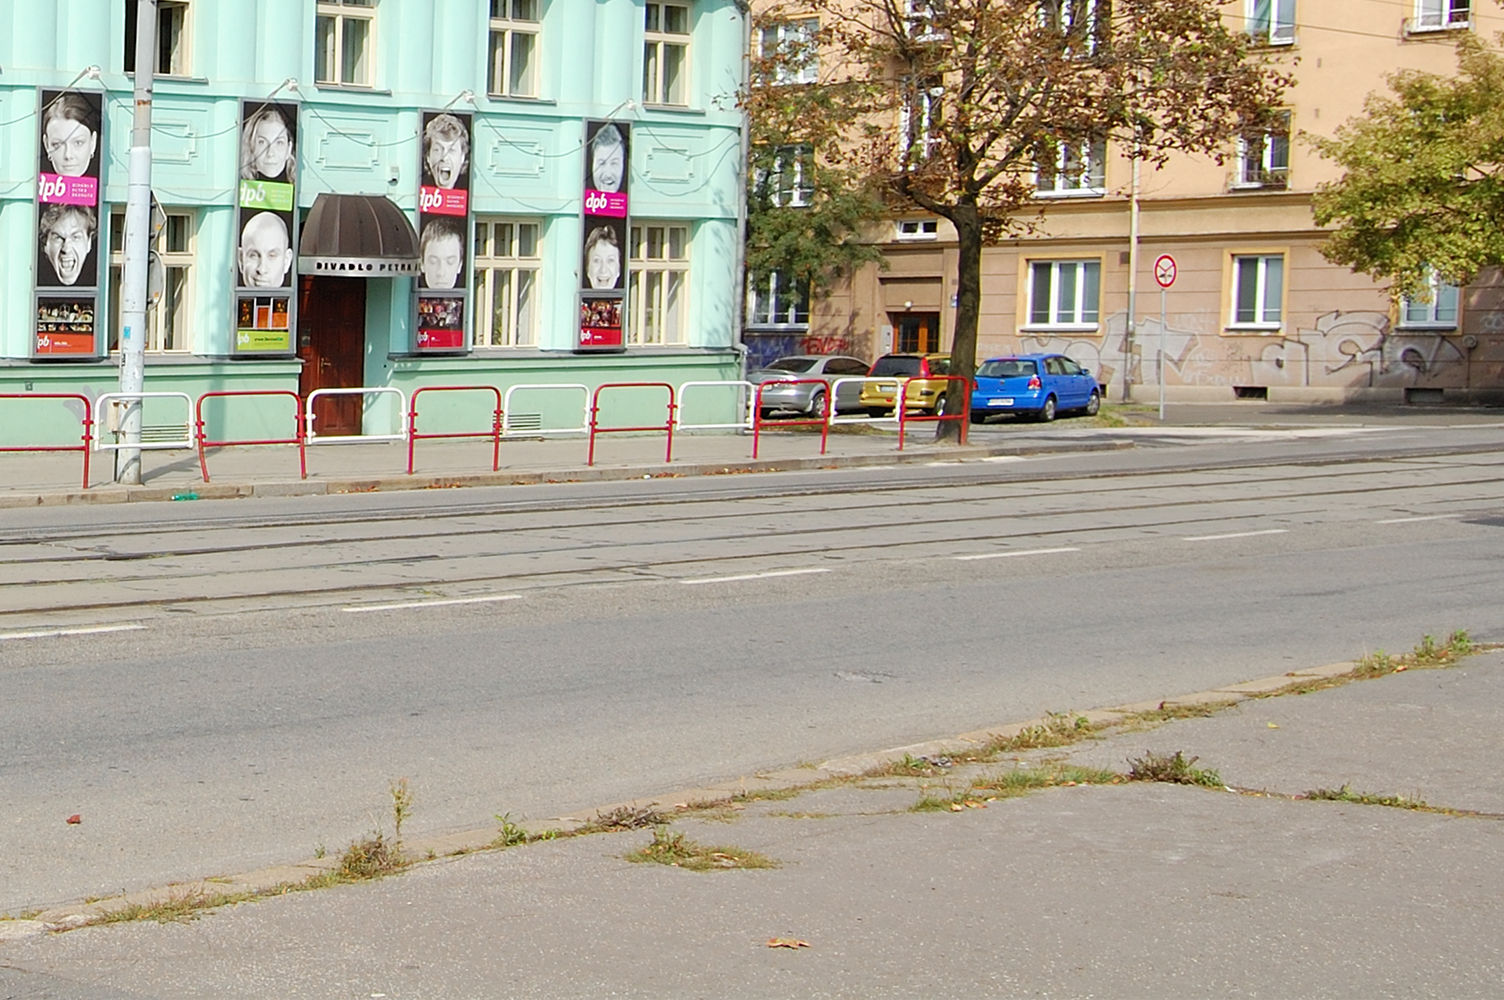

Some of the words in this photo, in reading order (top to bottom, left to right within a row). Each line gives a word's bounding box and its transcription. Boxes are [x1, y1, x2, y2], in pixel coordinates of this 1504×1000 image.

[586, 192, 607, 213] dpb
[316, 262, 373, 272] DIVADLO
[379, 263, 412, 272] PETRA
[37, 335, 50, 349] pb
